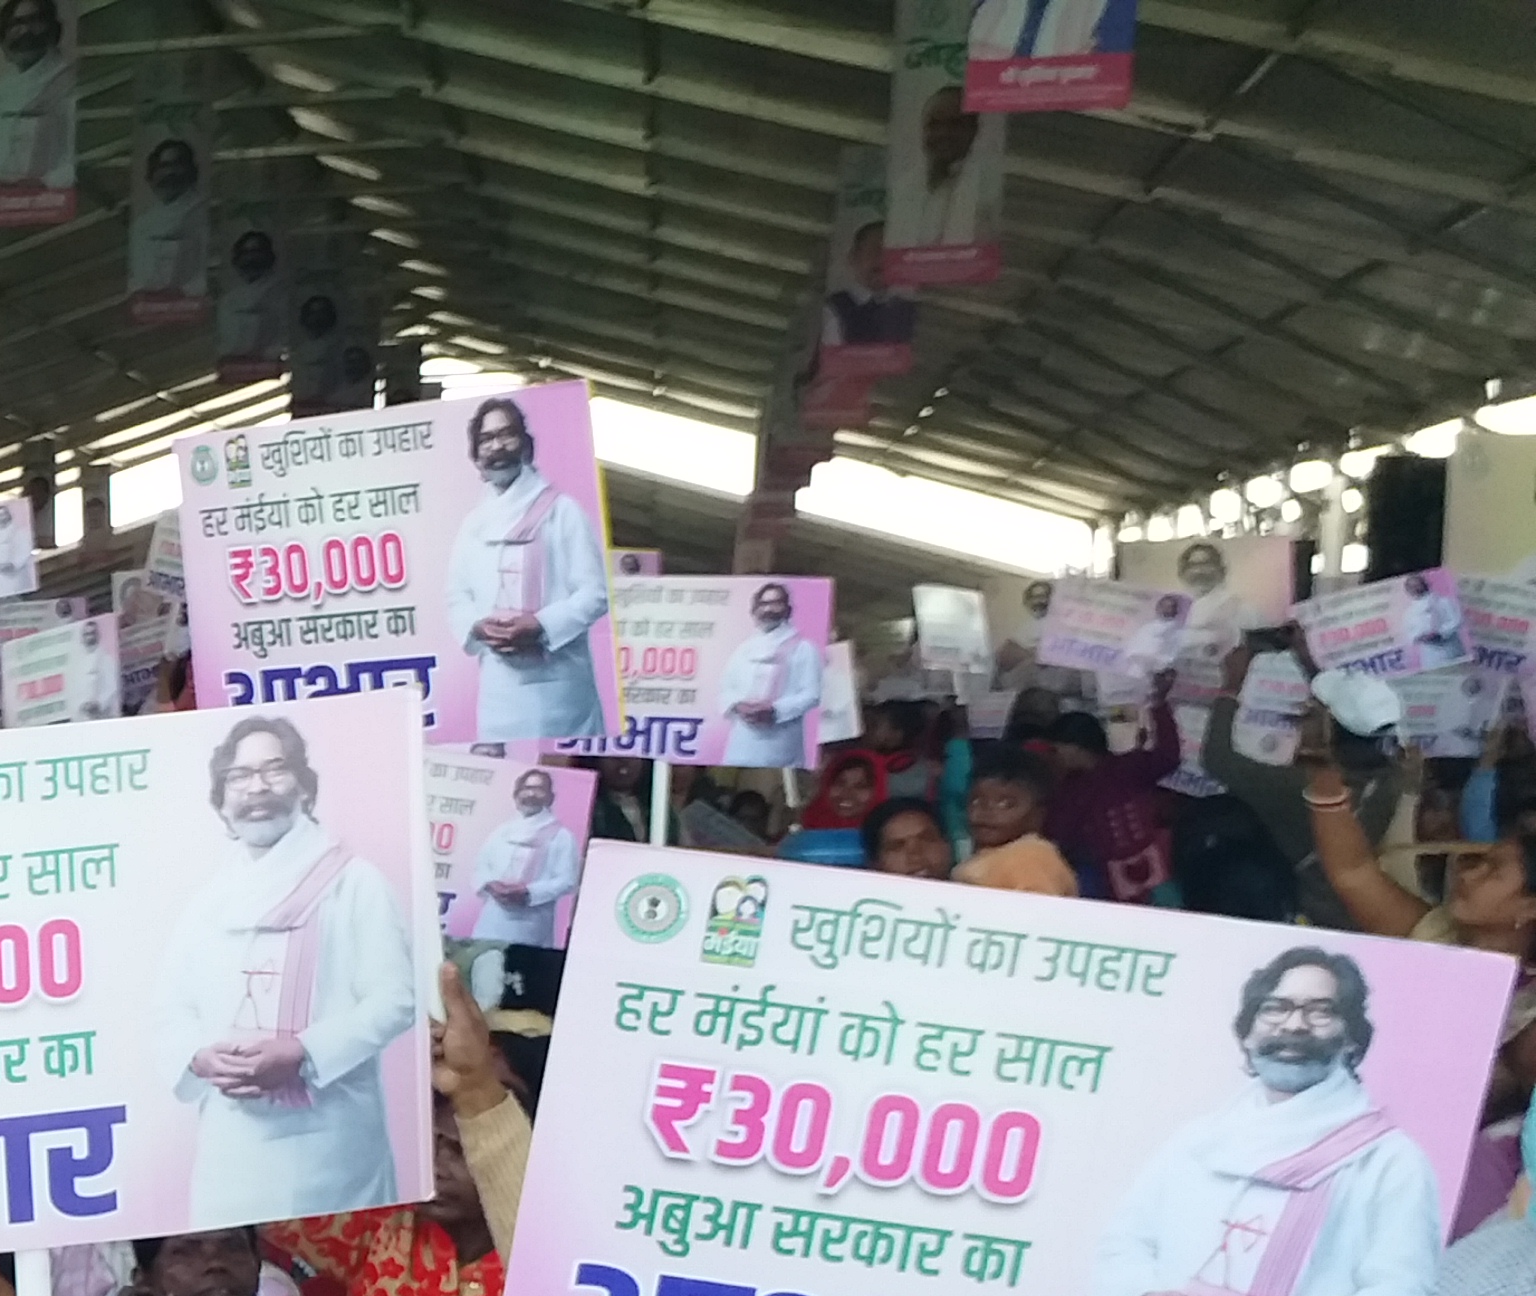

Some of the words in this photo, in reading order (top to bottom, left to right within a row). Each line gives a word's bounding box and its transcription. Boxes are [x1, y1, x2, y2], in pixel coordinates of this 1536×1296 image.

[335, 431, 363, 459] का
[367, 421, 432, 456] उपहार
[198, 507, 228, 537] हर
[294, 487, 324, 525] को
[328, 490, 360, 522] हर
[364, 483, 419, 517] साल
[229, 532, 404, 600] ₹30,000
[230, 618, 291, 659] अबुआ
[295, 610, 379, 645] सरकार
[382, 607, 415, 638] का
[34, 748, 152, 800] उपहार
[21, 843, 121, 896] साल
[790, 897, 960, 969] खुशियों
[966, 926, 1026, 977] का
[1034, 936, 1177, 996] उपहार
[38, 1031, 97, 1078] का
[615, 981, 685, 1035] हर
[838, 1000, 905, 1065] को
[914, 1021, 985, 1076] हर
[995, 1032, 1113, 1093] साल
[652, 1064, 1040, 1196] ₹30,000
[615, 1184, 760, 1257] अबुआ
[771, 1206, 953, 1276] सरकार
[961, 1233, 1031, 1287] का
